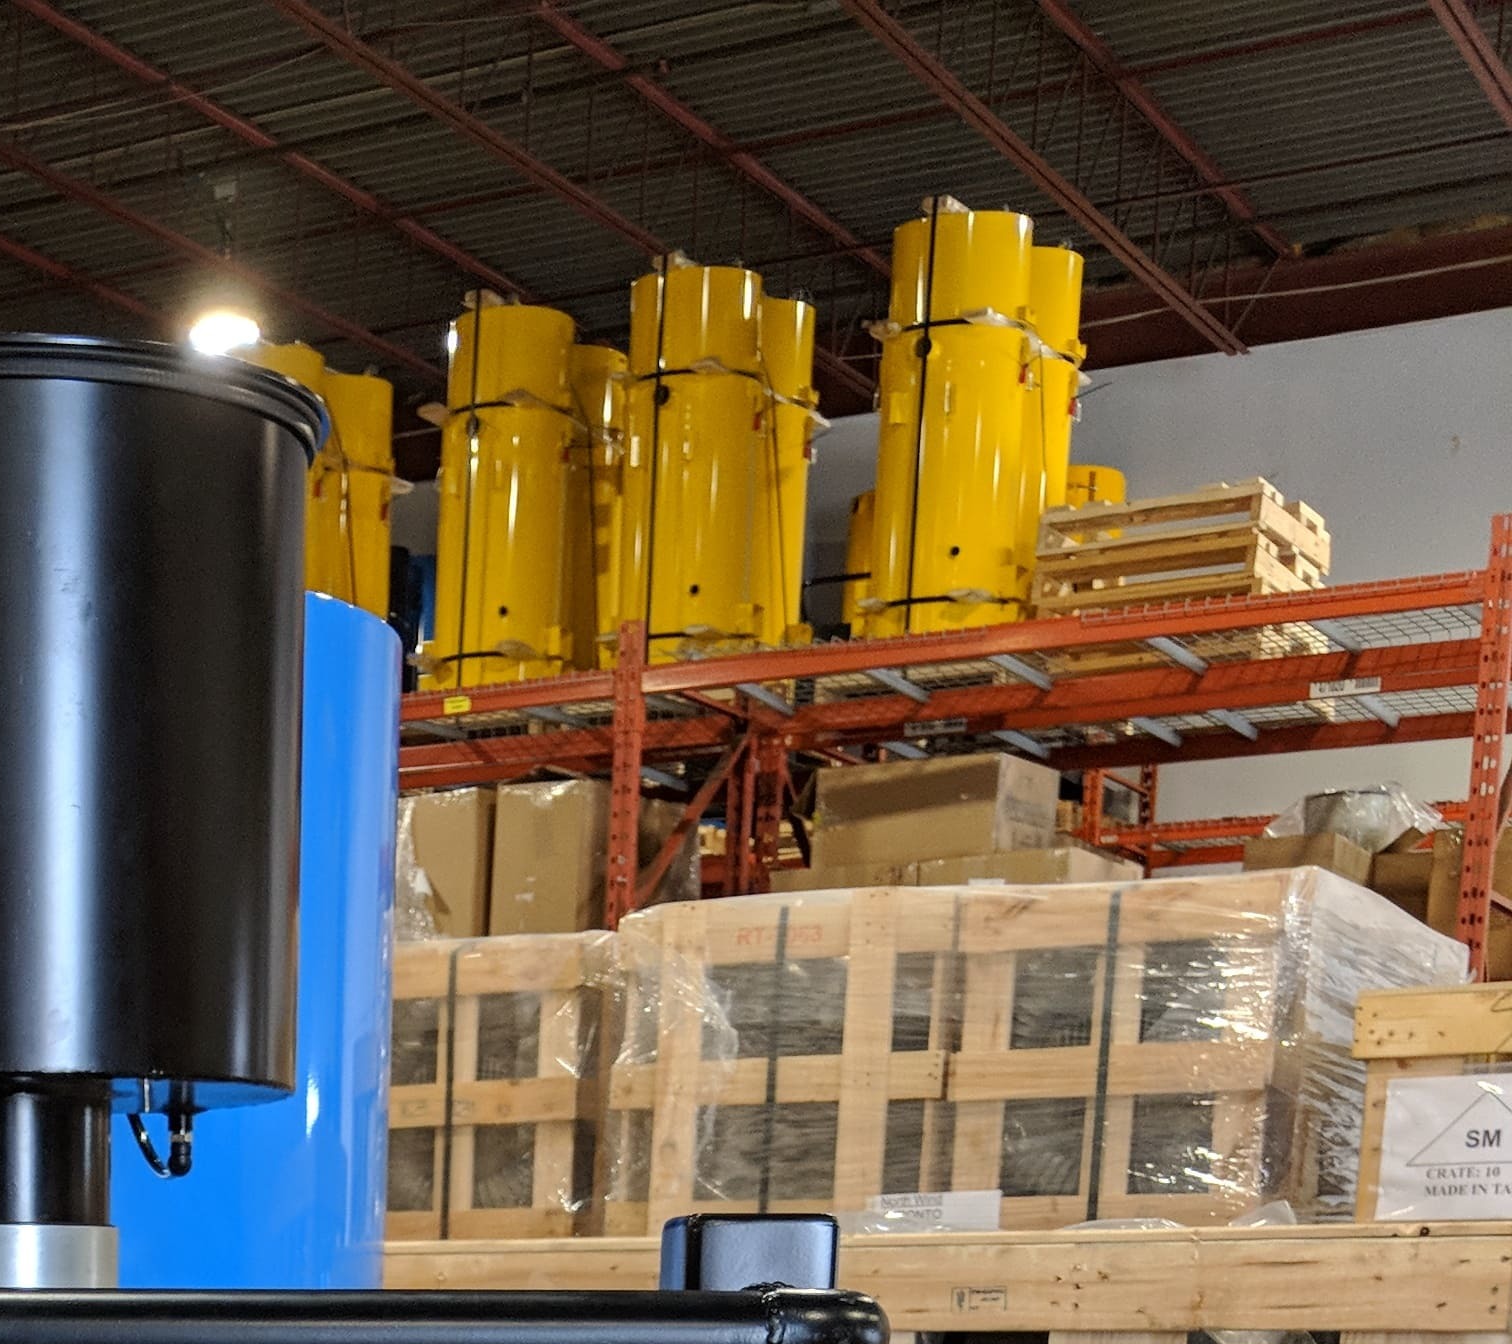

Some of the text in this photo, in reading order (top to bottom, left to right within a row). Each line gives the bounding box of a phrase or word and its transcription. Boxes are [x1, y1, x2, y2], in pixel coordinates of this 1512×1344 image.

[1465, 1130, 1501, 1148] SM
[1425, 1167, 1480, 1179] CRATE:
[1425, 1184, 1467, 1197] MADE
[1472, 1183, 1489, 1195] IN
